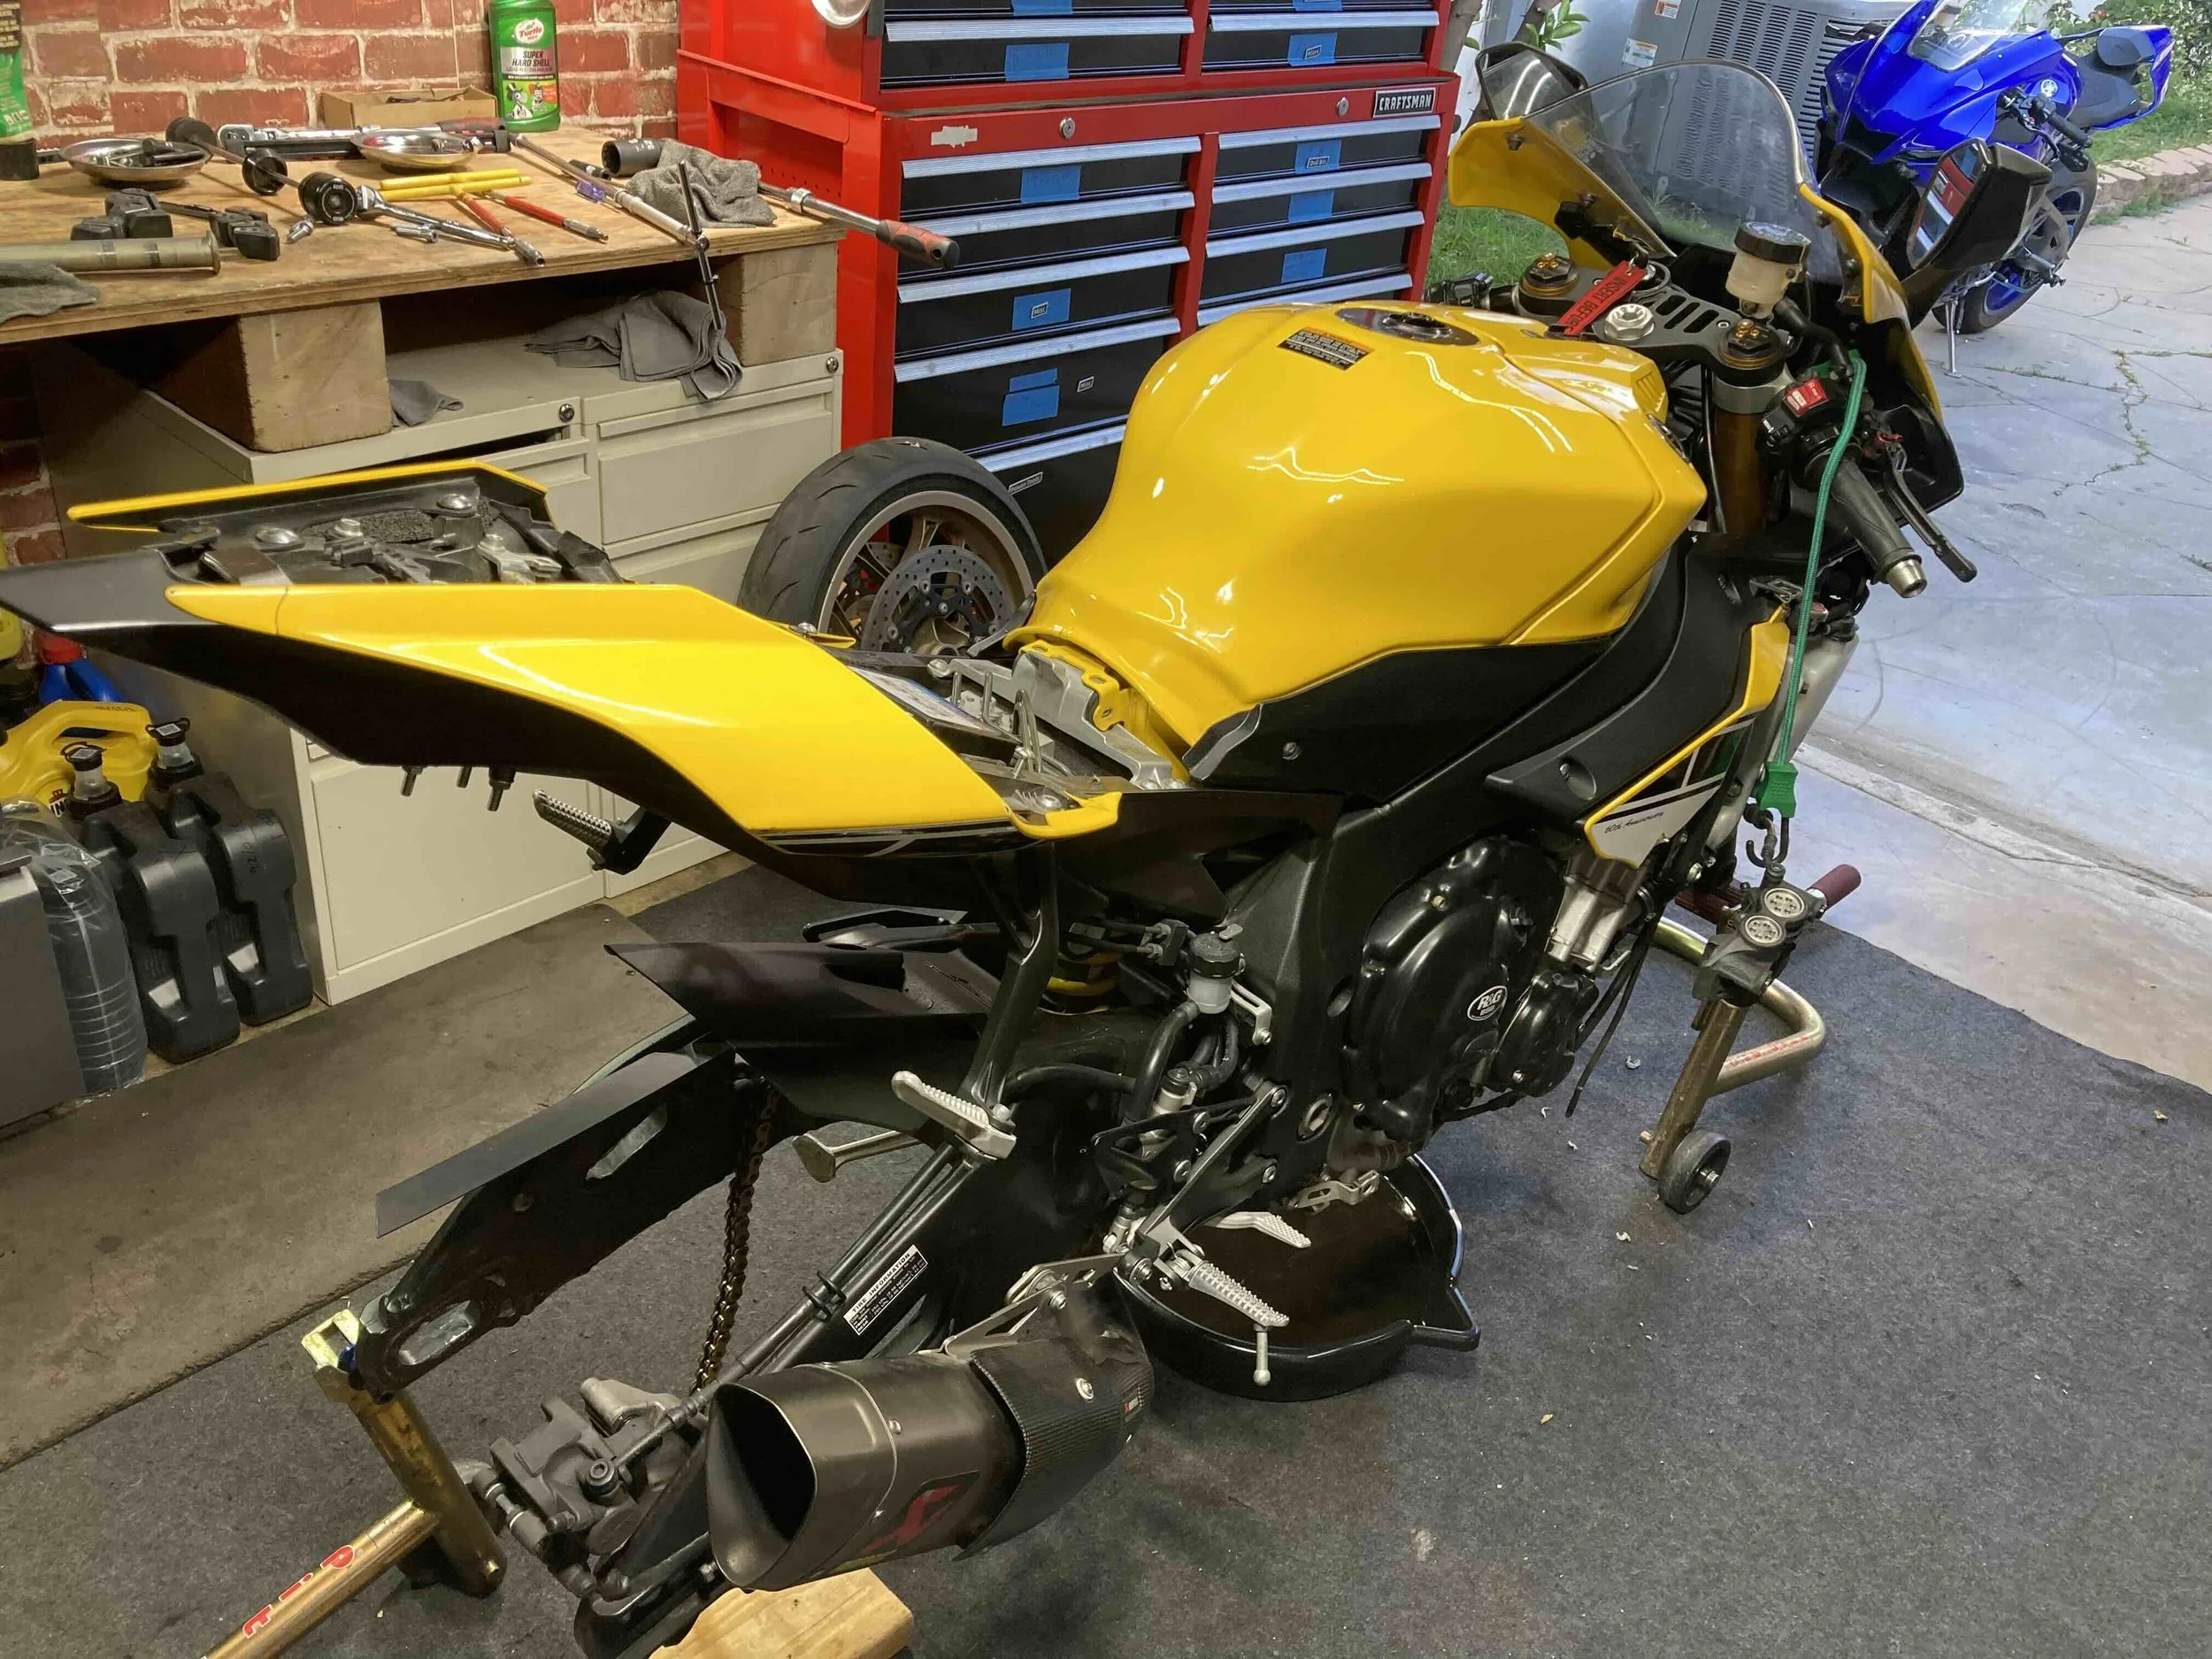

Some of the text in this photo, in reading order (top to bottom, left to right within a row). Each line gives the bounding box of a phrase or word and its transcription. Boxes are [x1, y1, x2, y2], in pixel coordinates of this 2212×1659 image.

[518, 27, 542, 37] Turtle
[511, 58, 550, 67] HARD SHELL
[1379, 94, 1432, 111] CRAFTSMAN
[852, 1253, 910, 1313] TIRE INFORMATION
